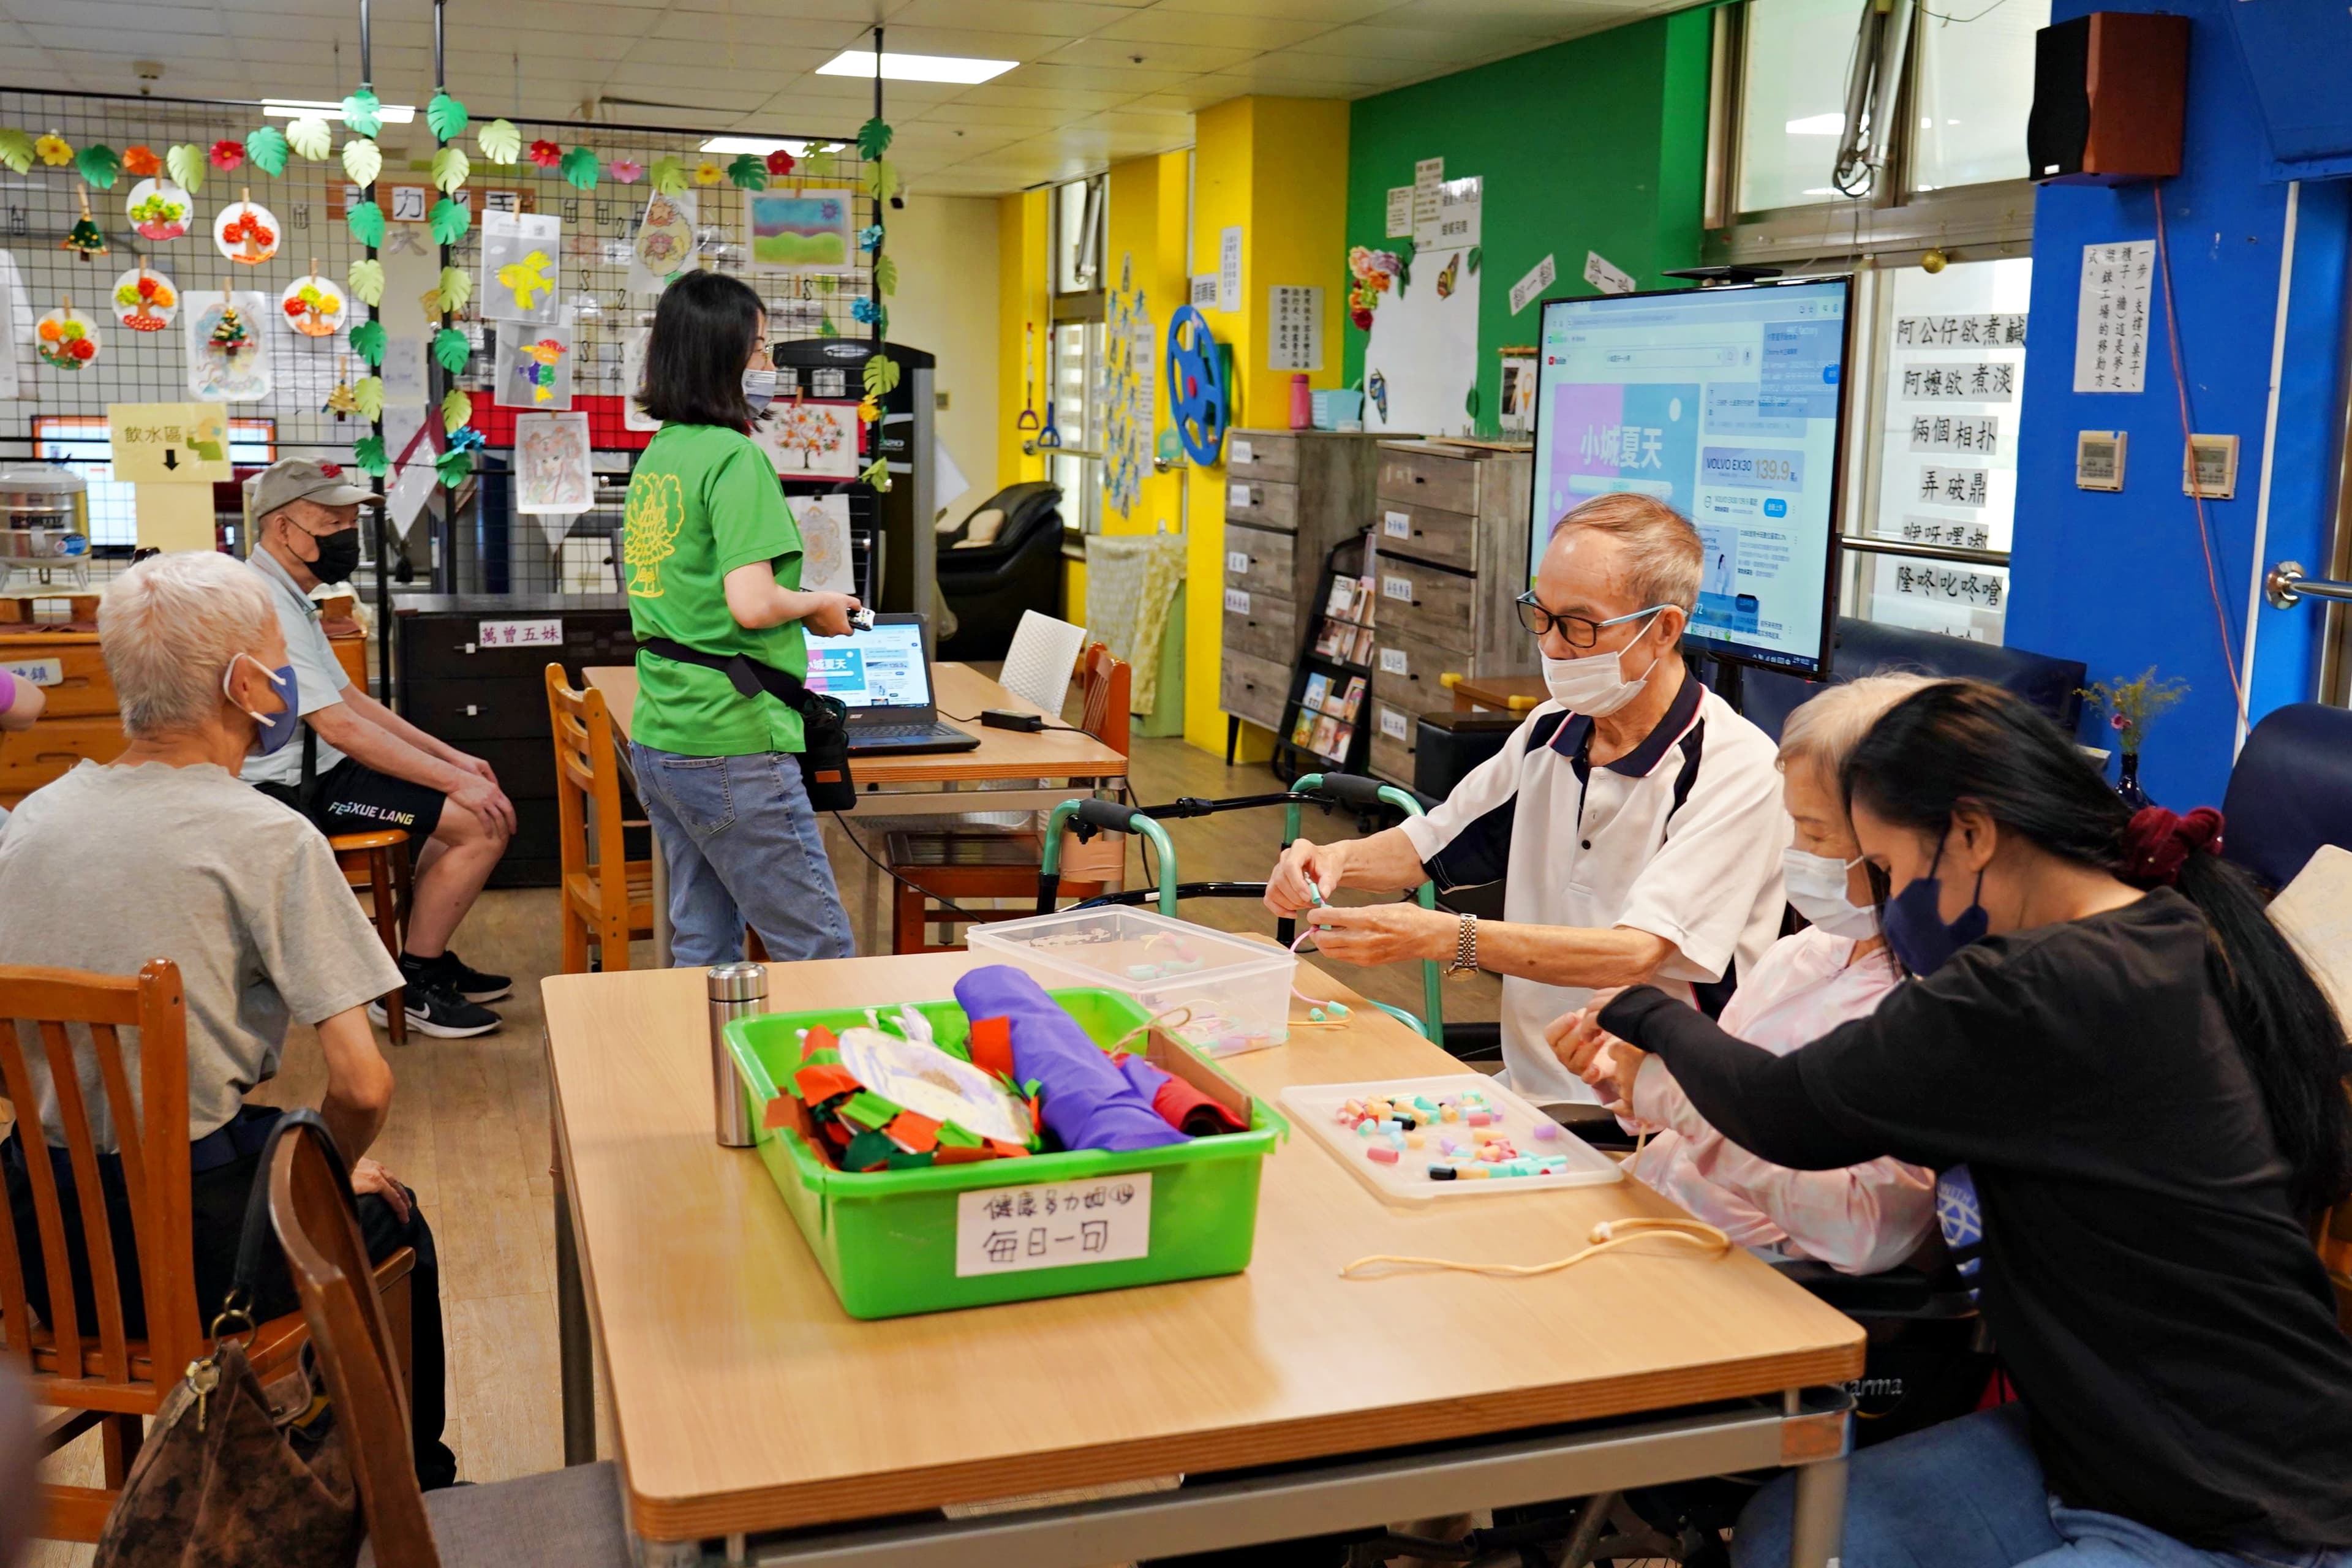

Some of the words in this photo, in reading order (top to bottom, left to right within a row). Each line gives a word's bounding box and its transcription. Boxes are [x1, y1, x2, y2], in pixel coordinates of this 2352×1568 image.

[124, 425, 183, 443] 飲水區
[1580, 424, 1663, 470] 小城夏天
[1706, 458, 1731, 470] VOLVO
[1732, 459, 1752, 471] EX30
[1755, 460, 1790, 481] 139.9
[482, 625, 560, 644] 萬曾五妹
[378, 808, 415, 826] LANG
[982, 1220, 1109, 1263] 每日一句
